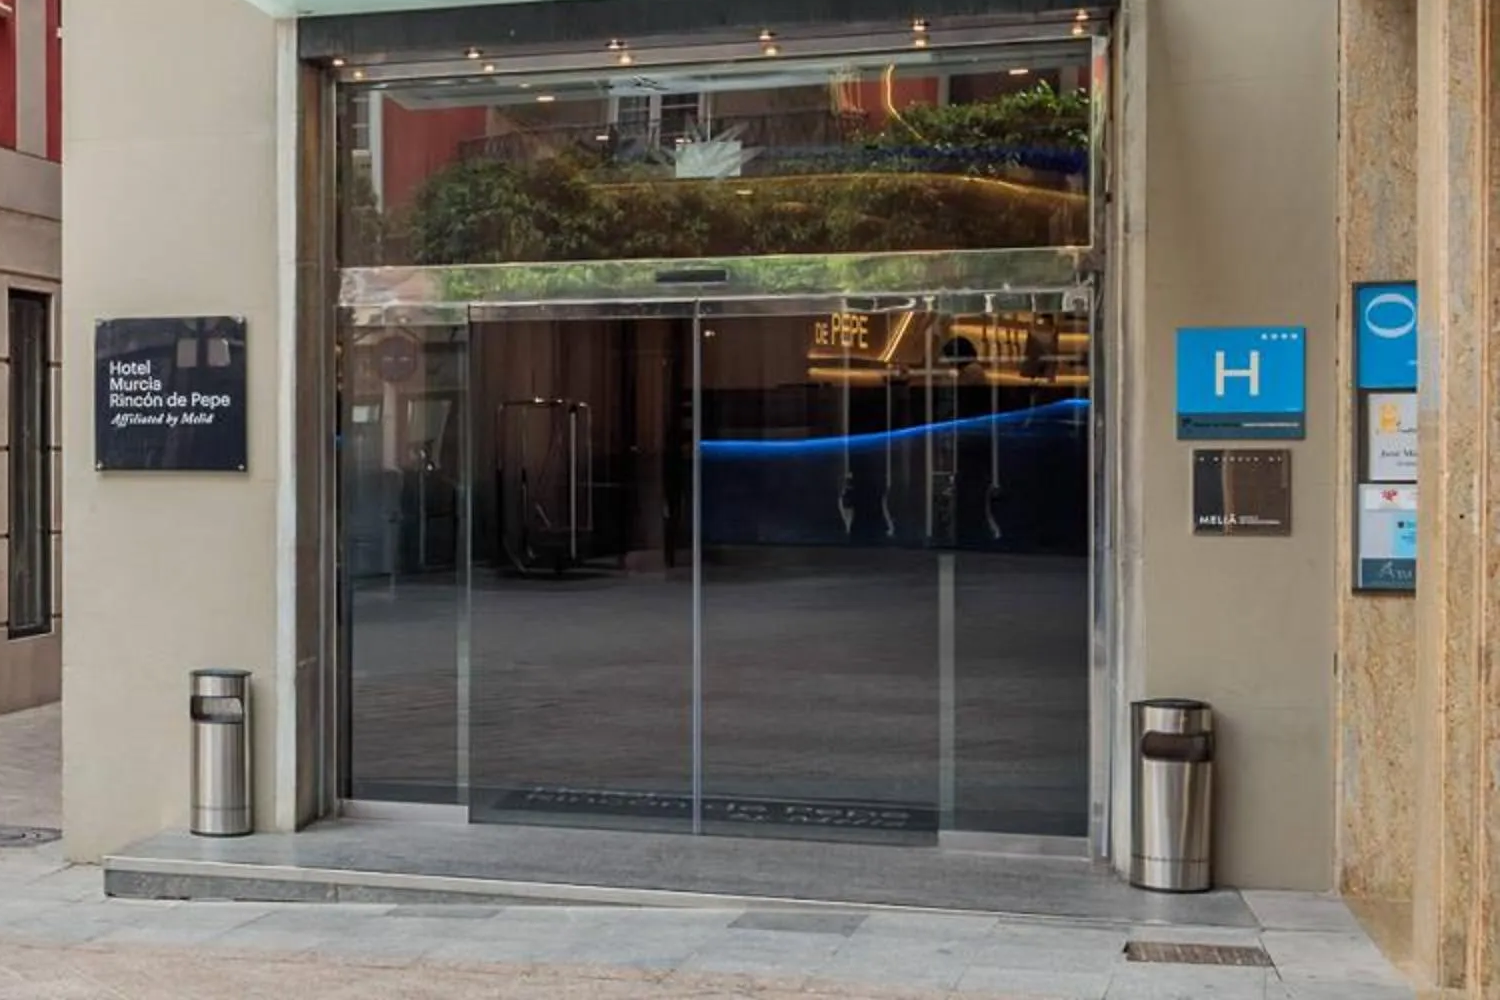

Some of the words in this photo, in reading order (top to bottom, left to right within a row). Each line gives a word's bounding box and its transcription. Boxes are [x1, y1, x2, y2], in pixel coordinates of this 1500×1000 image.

[831, 311, 869, 349] PEPE
[108, 359, 151, 376] Hotel
[1214, 350, 1260, 397] H
[108, 375, 163, 392] Murcia
[108, 391, 164, 408] Rincón
[166, 391, 188, 407] de
[191, 391, 232, 410] Pepe
[165, 412, 180, 428] by
